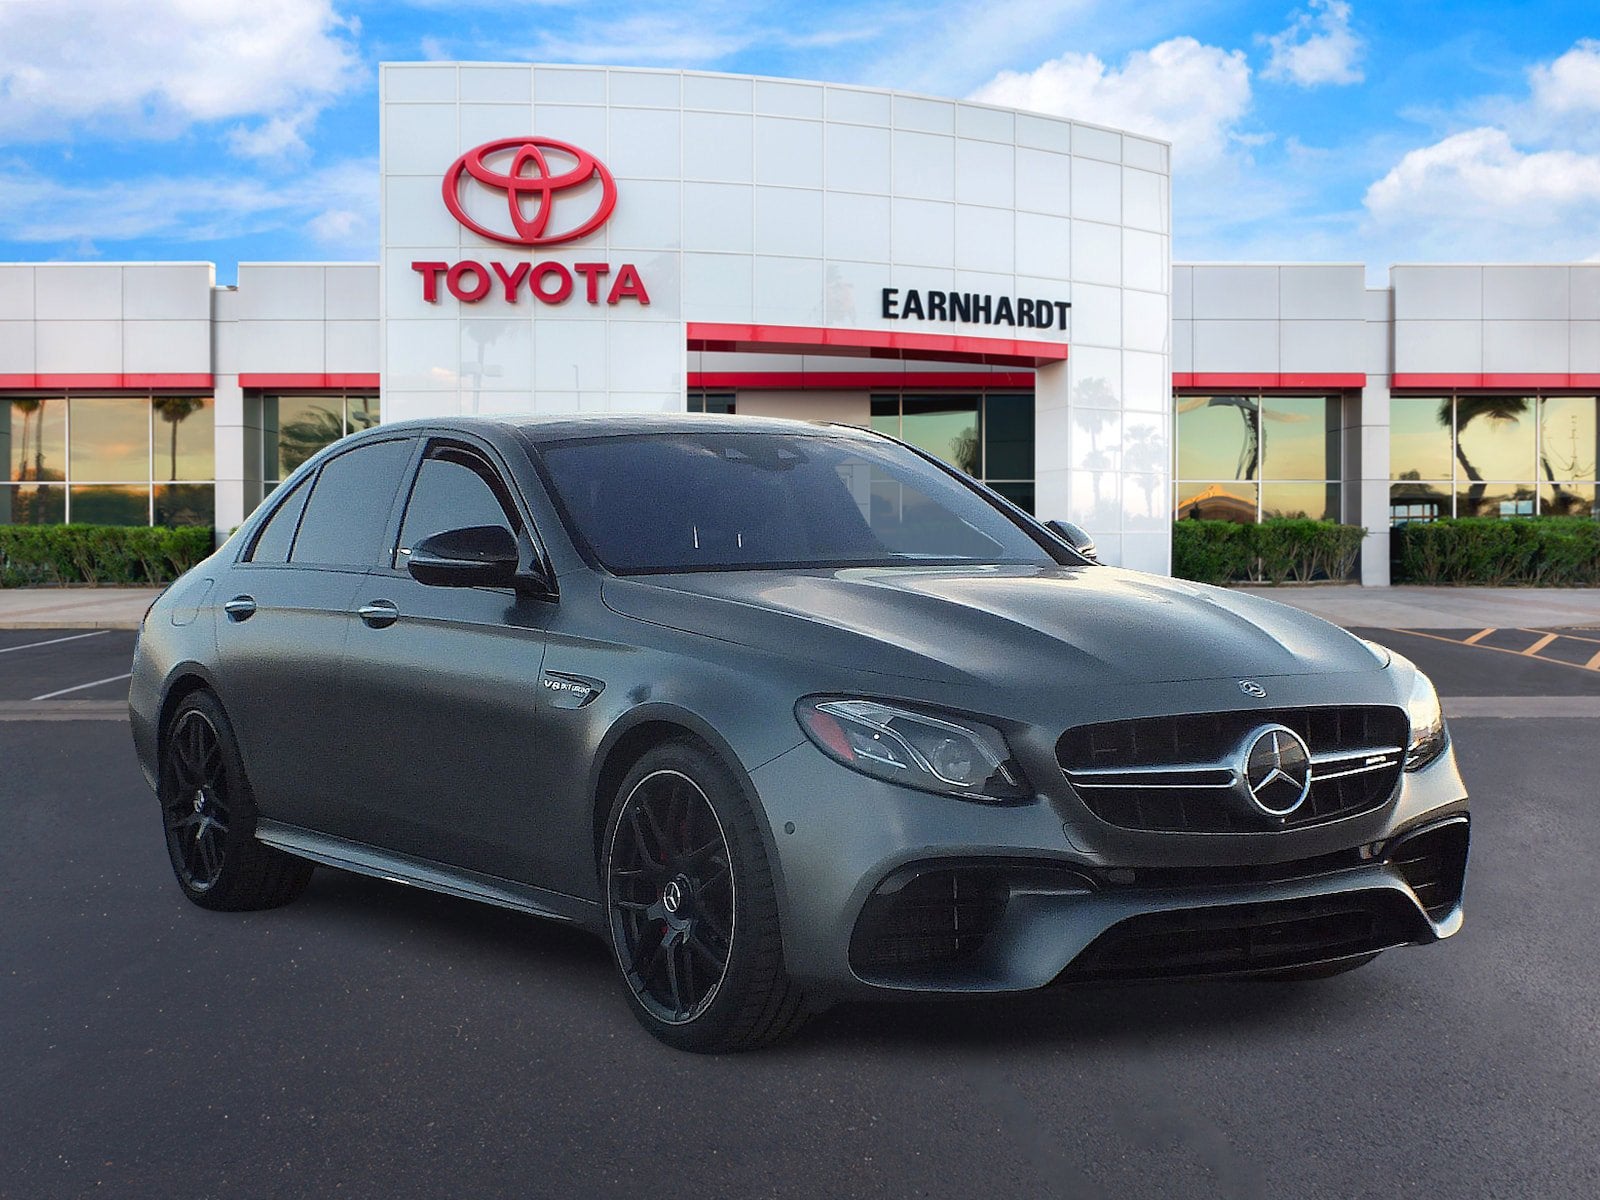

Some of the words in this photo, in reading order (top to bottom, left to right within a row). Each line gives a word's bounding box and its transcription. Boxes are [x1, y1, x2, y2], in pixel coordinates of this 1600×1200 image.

[412, 261, 649, 304] TOYOTA
[883, 288, 1071, 330] EARNHARDT
[544, 679, 560, 691] V8
